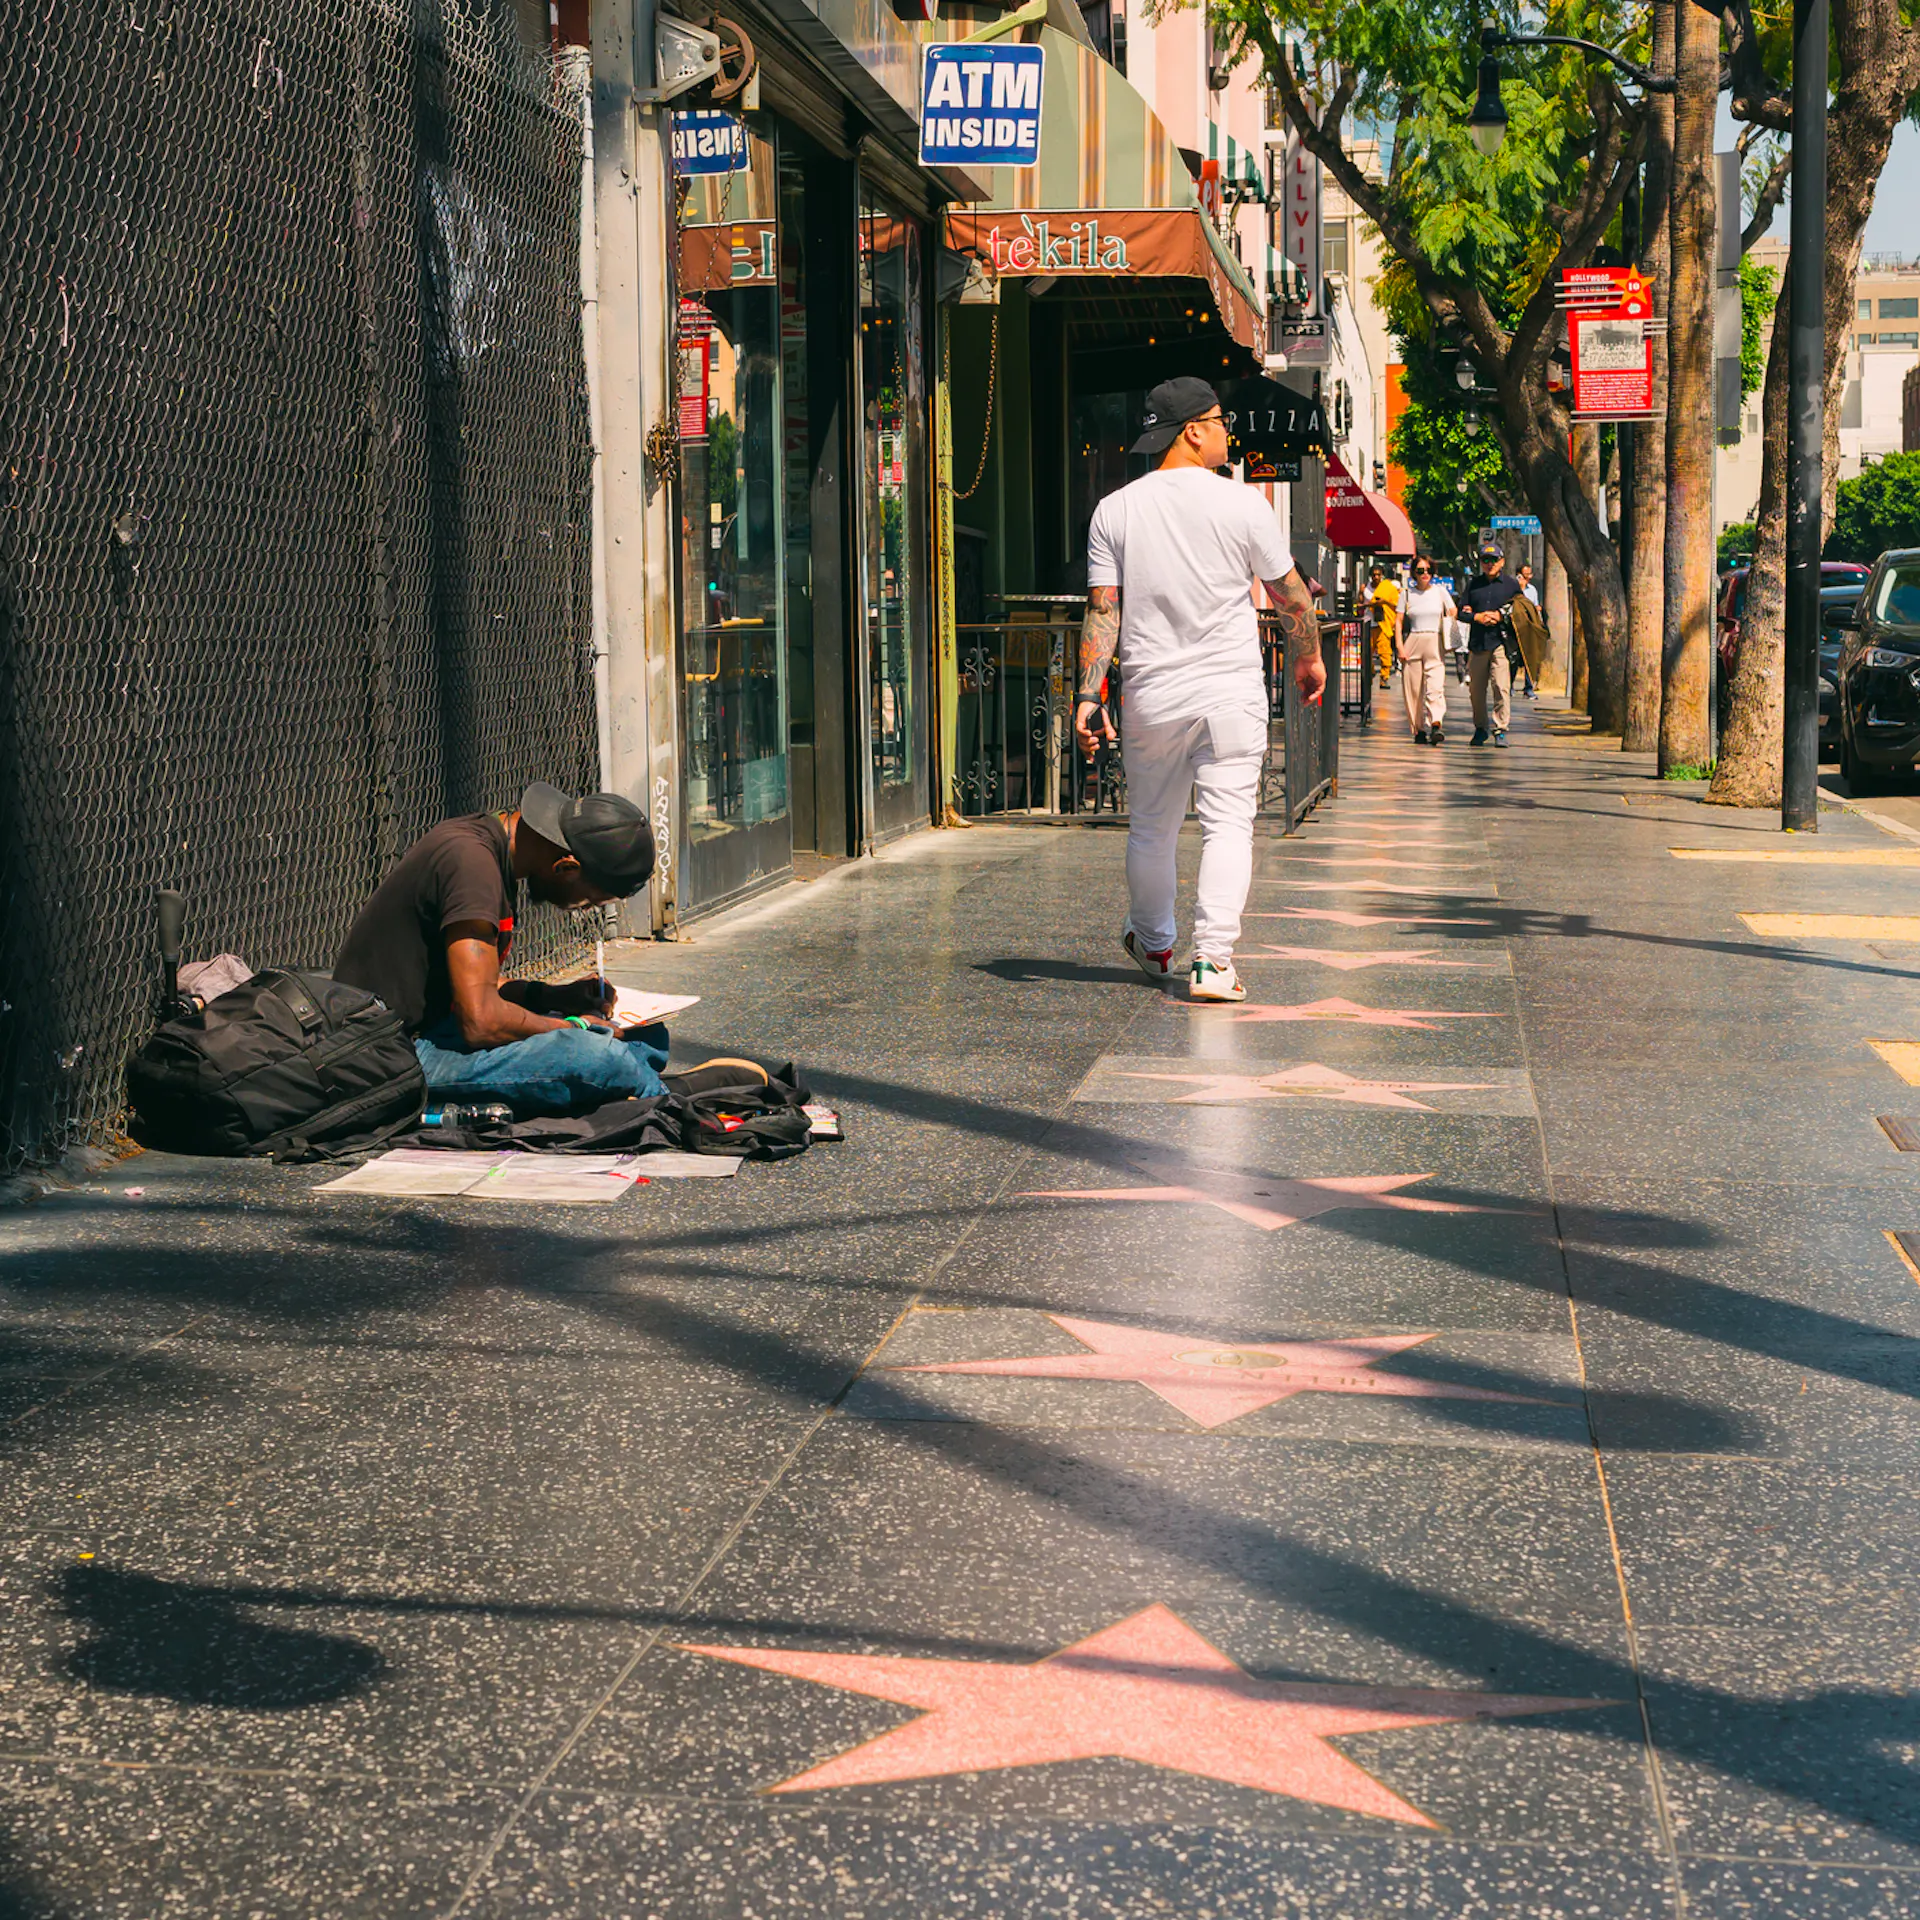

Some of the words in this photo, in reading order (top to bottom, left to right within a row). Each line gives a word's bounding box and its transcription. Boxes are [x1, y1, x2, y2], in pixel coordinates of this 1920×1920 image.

[926, 61, 1040, 109] ATM
[924, 117, 1036, 148] INSIDE
[987, 213, 1130, 271] tèkila
[1570, 273, 1610, 282] HOLLYWOOD
[1628, 282, 1640, 291] 10
[1285, 325, 1320, 335] APTS
[1227, 409, 1319, 433] PIZZA
[1326, 475, 1352, 487] DRINKS
[1337, 488, 1345, 497] &
[1326, 495, 1364, 508] SOUVENIR
